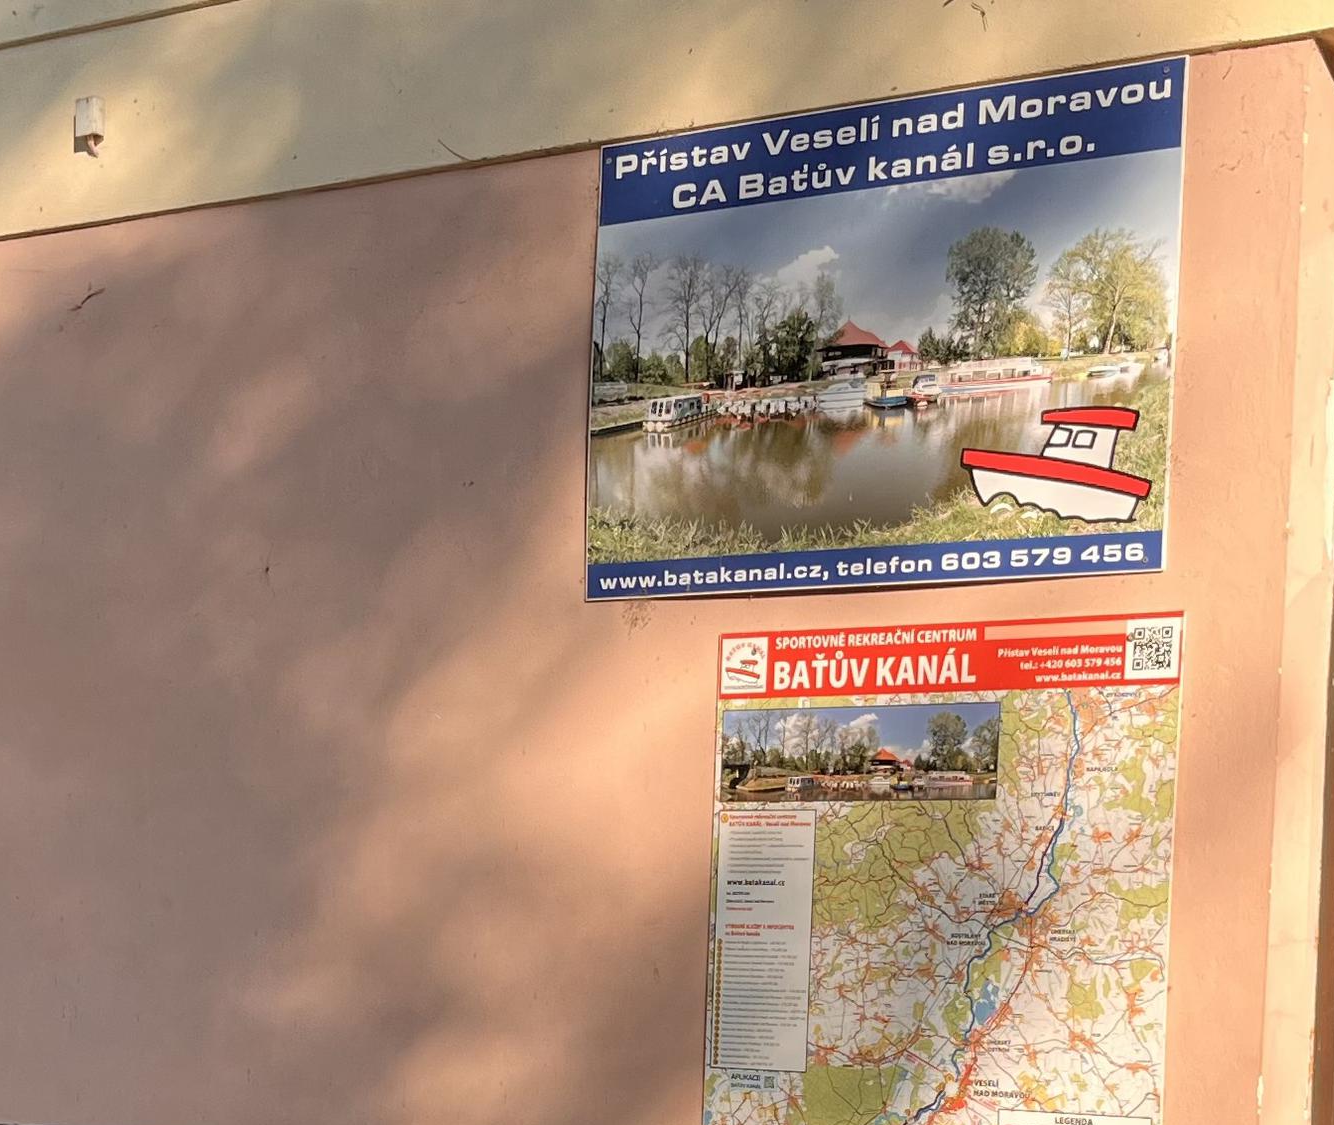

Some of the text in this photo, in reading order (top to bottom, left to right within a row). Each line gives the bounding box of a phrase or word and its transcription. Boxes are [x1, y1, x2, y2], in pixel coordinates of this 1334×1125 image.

[616, 77, 1173, 179] Přístav Veselí nad Moravou
[672, 134, 1097, 210] CA Baťův kanál s.r.o.
[599, 542, 1145, 590] www.batakanal.cz, telefon 603 579 456
[847, 628, 916, 646] REKREAČNÍ
[917, 629, 977, 645] CENTRUM
[998, 644, 1123, 658] Přístav Veselí nad Moravou
[773, 650, 870, 691] BAŤŮV
[875, 647, 977, 687] KANÁL
[1040, 660, 1063, 670] +420
[1065, 659, 1082, 668] 603
[1084, 658, 1103, 667] 579
[1104, 657, 1122, 666] 456
[1035, 671, 1122, 683] www.batakanal.cz
[974, 1079, 999, 1088] VESELÍ
[973, 1090, 1031, 1099] NAD MORAVOU
